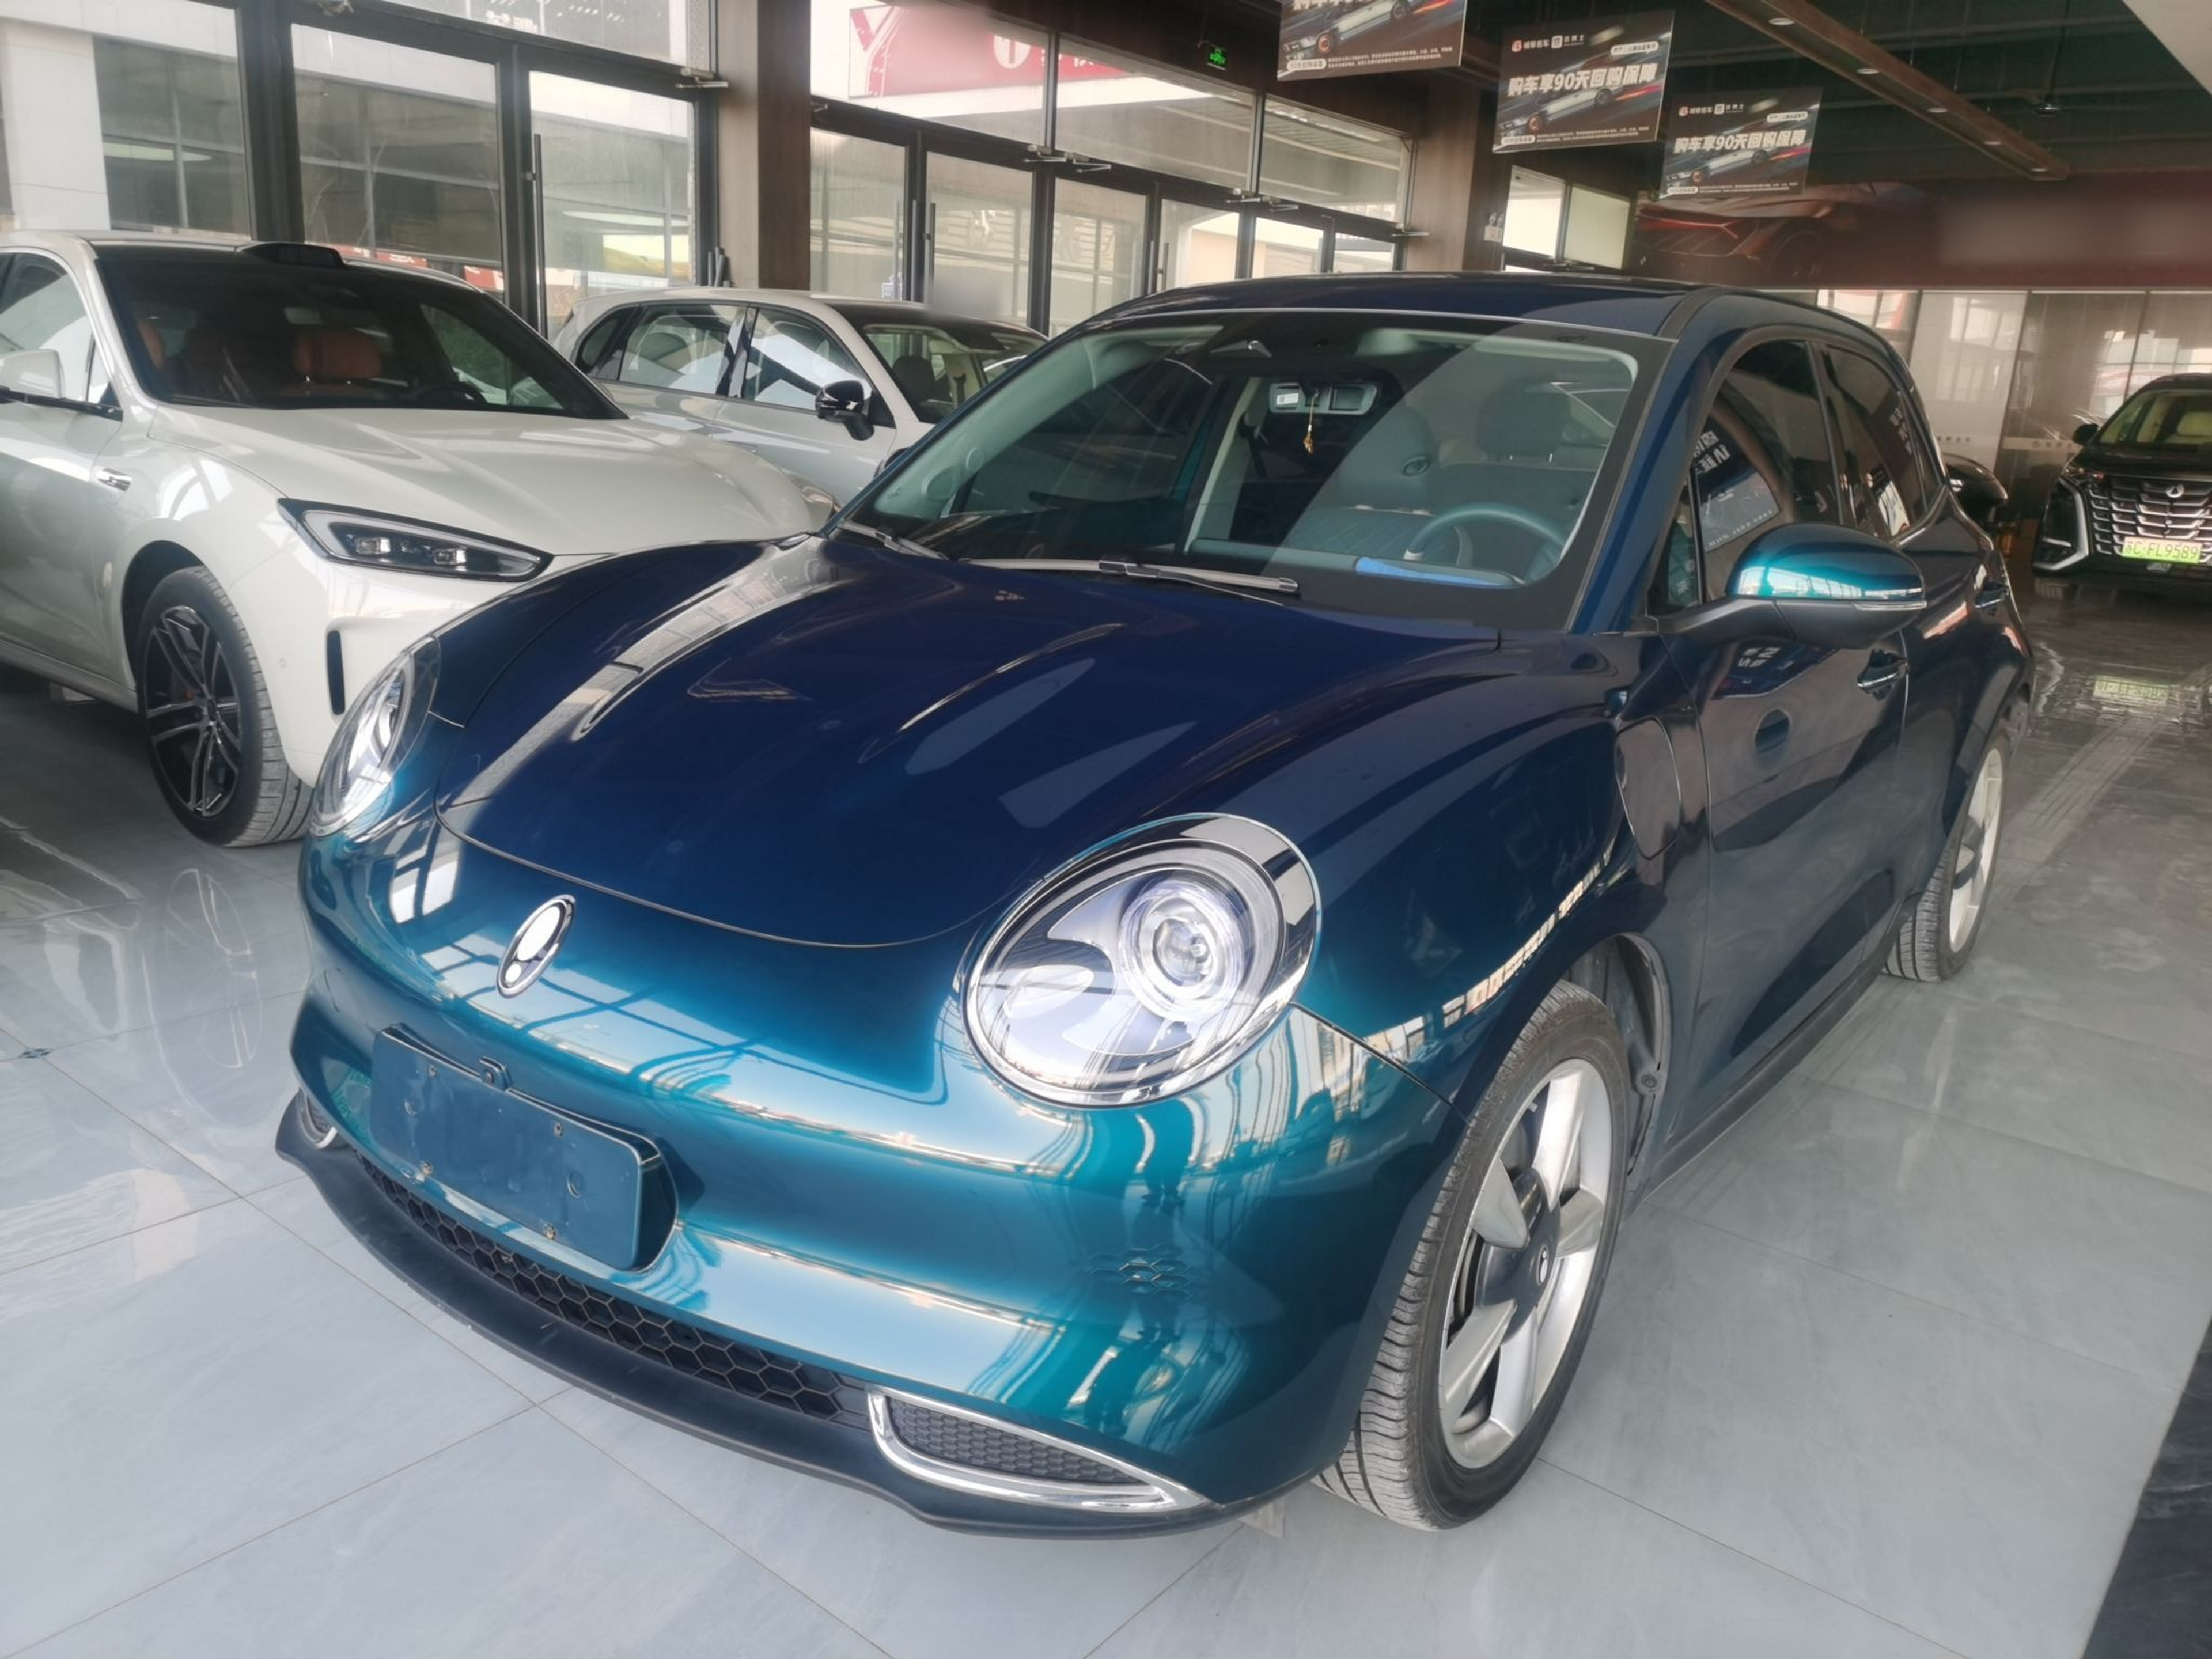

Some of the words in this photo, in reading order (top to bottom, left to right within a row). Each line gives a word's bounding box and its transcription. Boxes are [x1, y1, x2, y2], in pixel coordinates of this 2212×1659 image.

[1508, 63, 1658, 97] 购车享90天回购保障
[1673, 130, 1806, 153] 购车享90天回购保障
